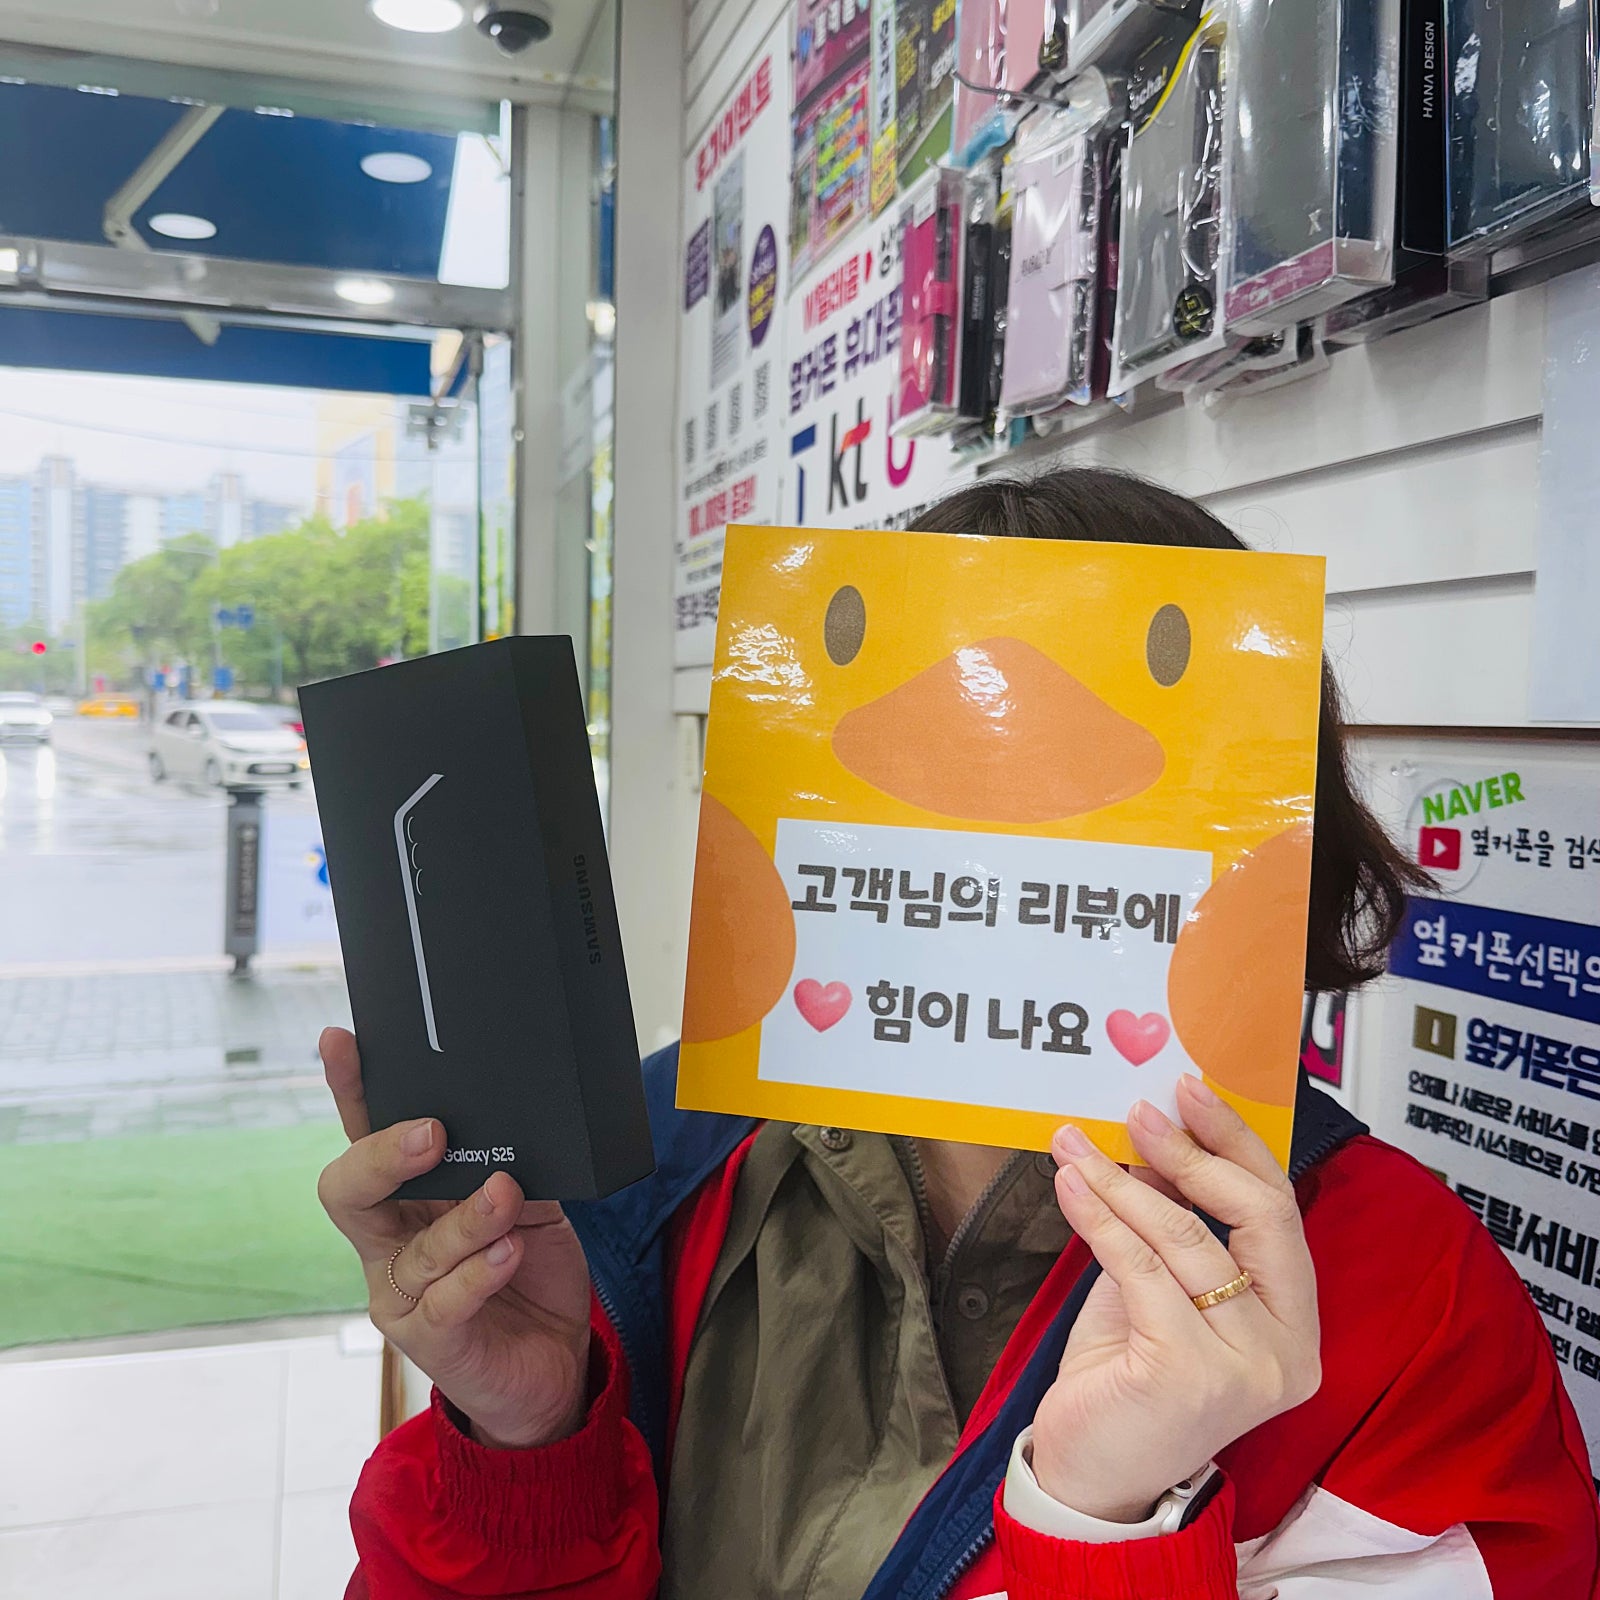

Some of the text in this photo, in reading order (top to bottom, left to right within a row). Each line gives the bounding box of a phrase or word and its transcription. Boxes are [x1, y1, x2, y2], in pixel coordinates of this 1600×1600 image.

[1422, 20, 1436, 119] HANA DESIGN
[827, 396, 872, 514] kt
[1421, 771, 1526, 826] NAVER
[1470, 825, 1554, 868] 옆커폰을
[573, 853, 602, 966] SAMSUNG
[791, 864, 1182, 944] 고객님의 리뷰에
[866, 979, 1092, 1056] 힘이 나요
[1405, 1102, 1474, 1147] 체계적인
[1473, 1126, 1564, 1180] 시스템으로
[1408, 1070, 1459, 1106] 언제나
[1460, 1086, 1513, 1125] 새로운
[1513, 1104, 1590, 1152] 서비스를
[443, 1146, 516, 1166] Galaxy S25
